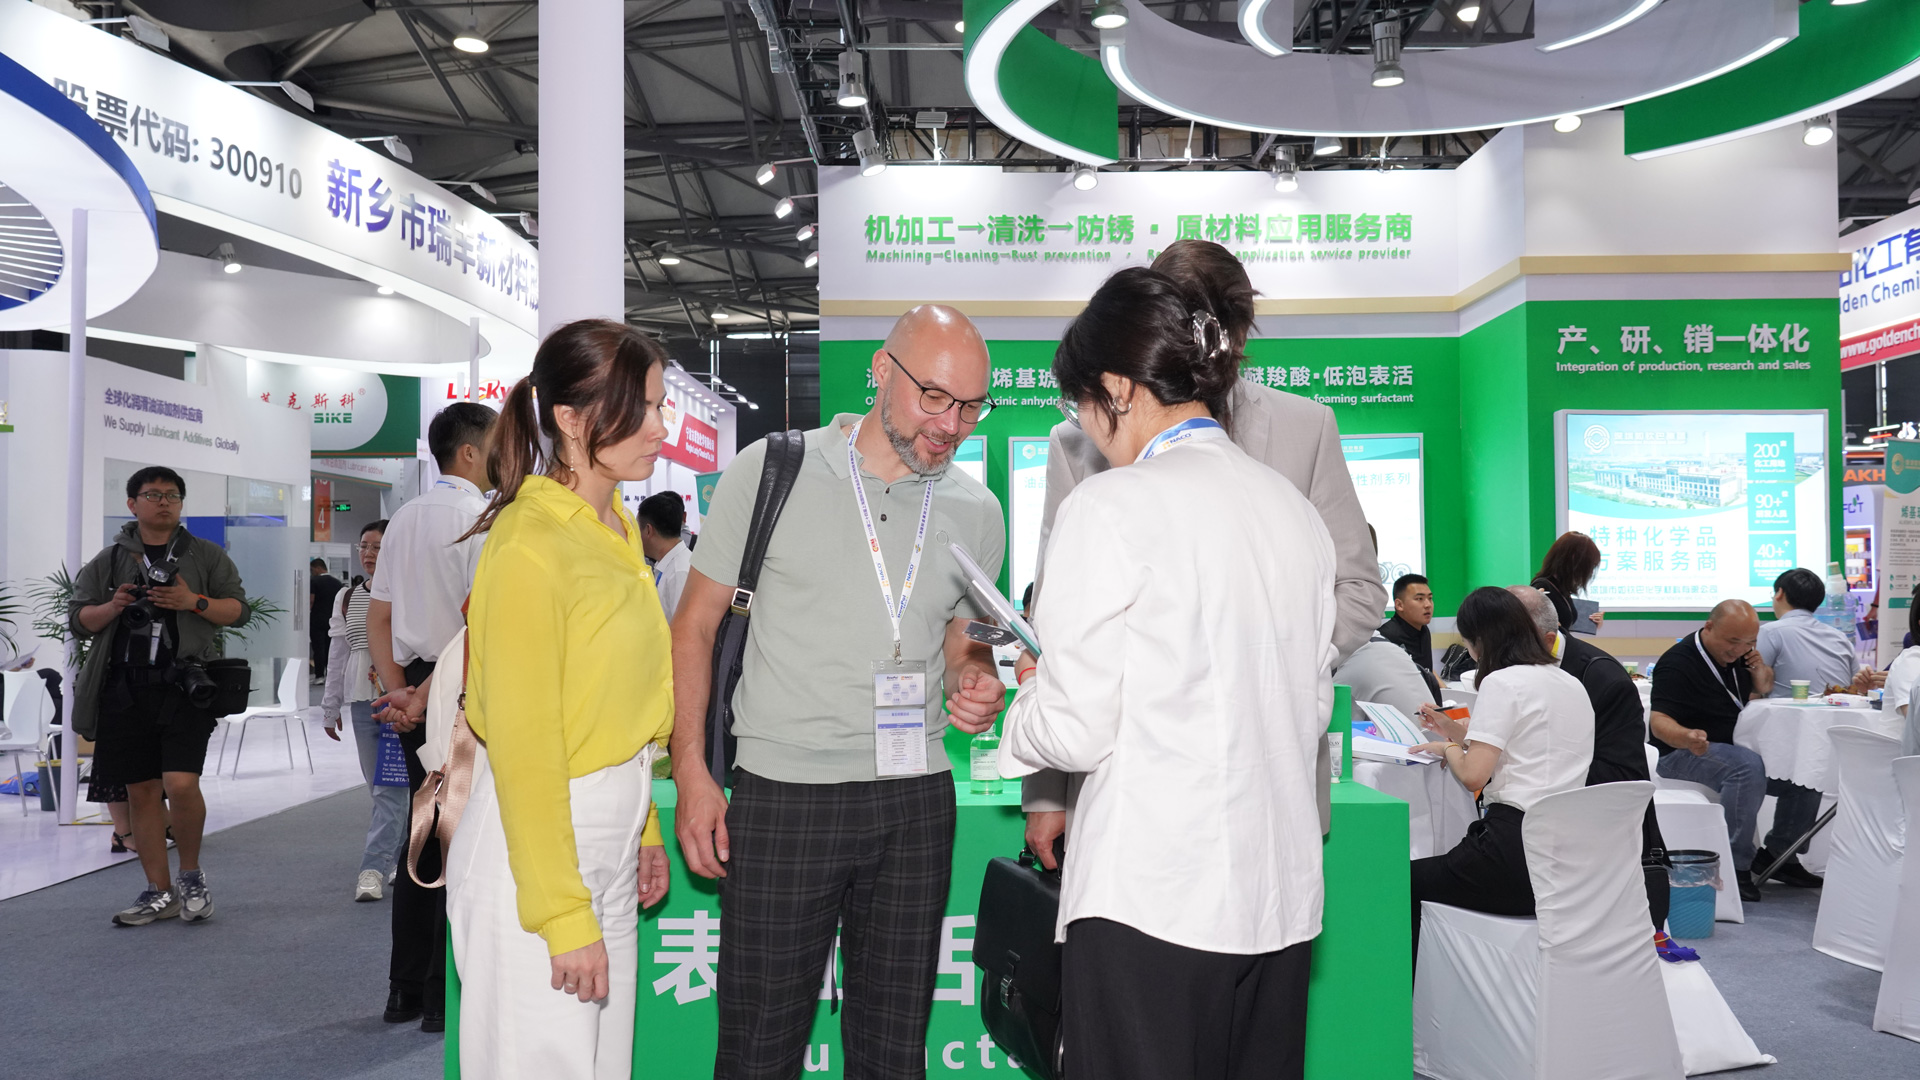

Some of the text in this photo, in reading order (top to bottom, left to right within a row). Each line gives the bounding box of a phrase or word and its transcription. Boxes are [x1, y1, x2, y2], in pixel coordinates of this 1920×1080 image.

[210, 137, 303, 199] 300910
[1175, 213, 1413, 243] 原材料应用服务商
[1044, 248, 1112, 265] prevention
[1235, 248, 1304, 264] application
[1311, 247, 1353, 260] service
[1359, 246, 1412, 262] provider
[1556, 359, 1812, 374] Integration of production, research and sales
[1361, 393, 1414, 404] surfactant
[104, 415, 240, 454] We Supply Lubricant Additives Globally
[1753, 443, 1780, 458] 200
[1755, 494, 1783, 509] 90+
[318, 507, 326, 529] 4
[1589, 525, 1717, 547] 特种化学品
[1756, 543, 1785, 558] 40+
